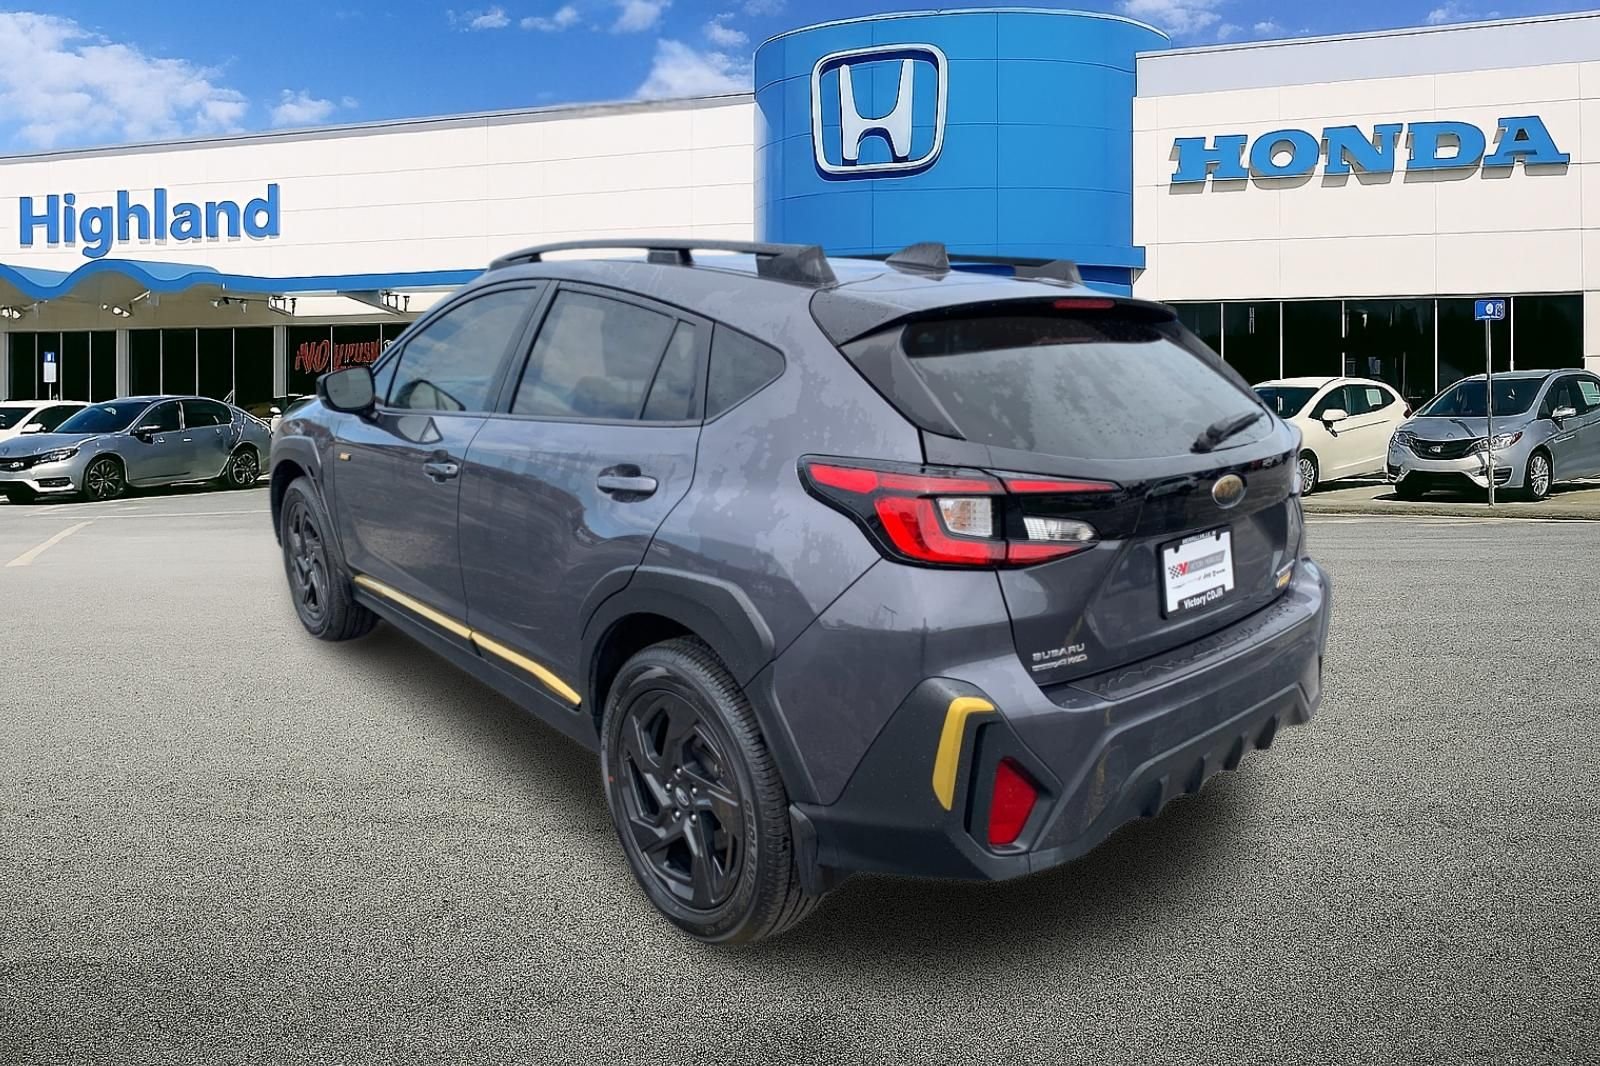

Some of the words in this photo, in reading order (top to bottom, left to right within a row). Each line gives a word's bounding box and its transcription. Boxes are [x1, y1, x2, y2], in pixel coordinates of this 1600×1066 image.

[1170, 115, 1570, 185] HONDA
[19, 183, 280, 258] Highland
[1183, 594, 1206, 609] Victory
[1032, 642, 1085, 661] SUBARU
